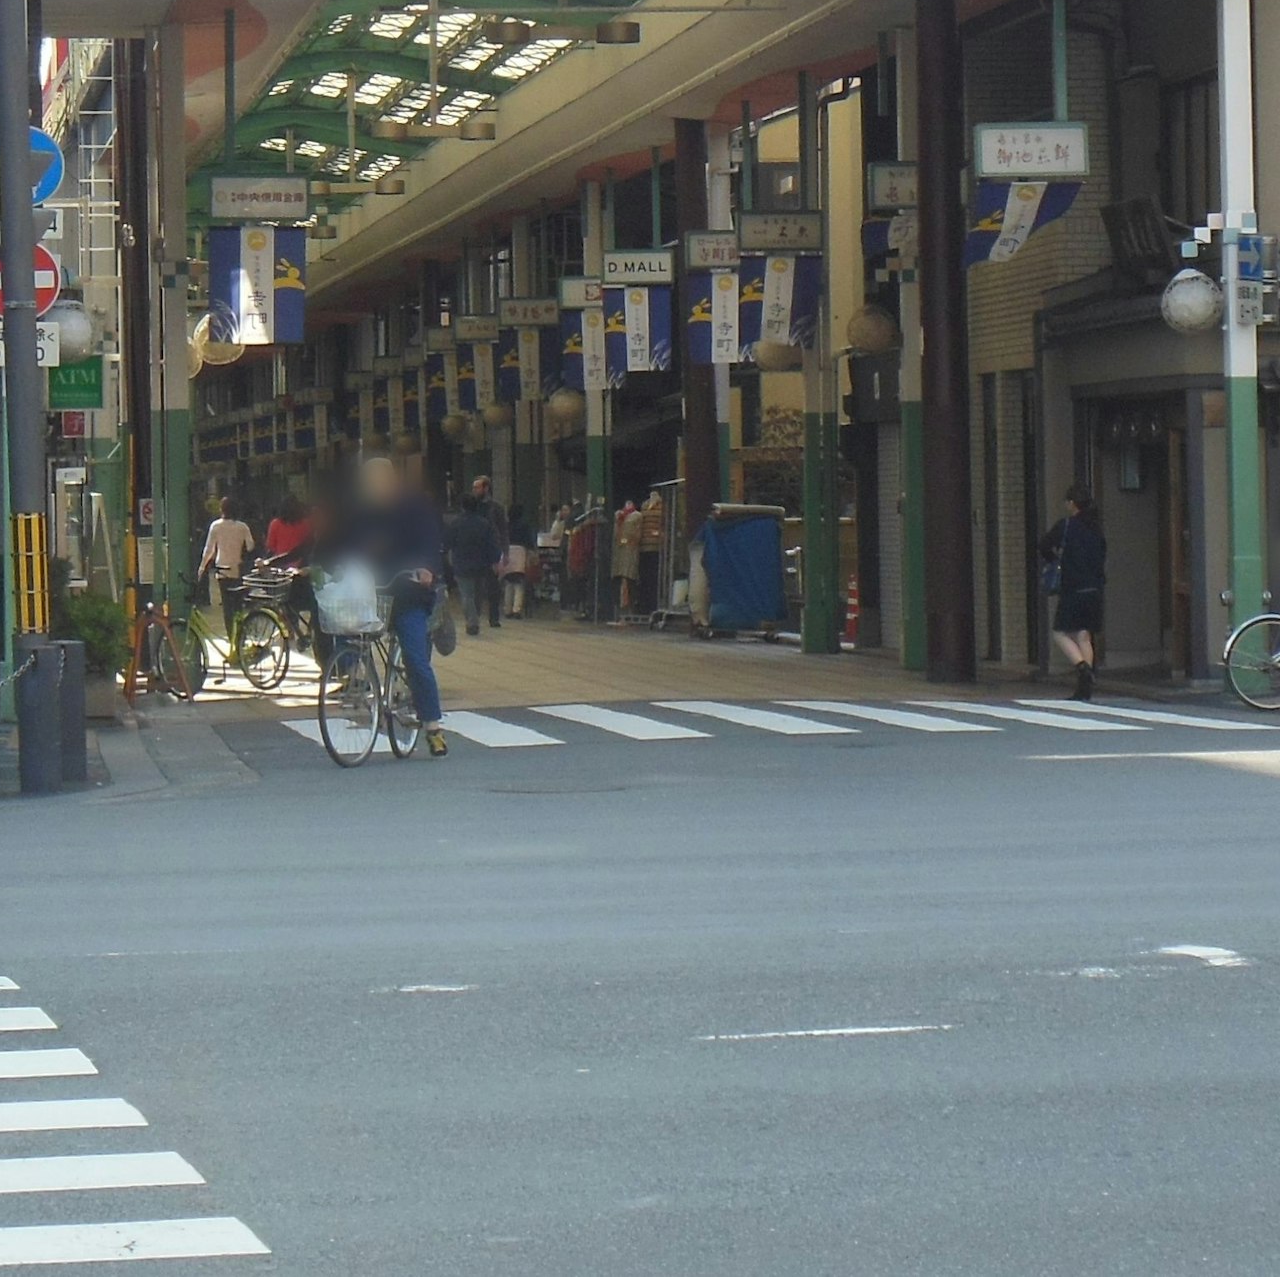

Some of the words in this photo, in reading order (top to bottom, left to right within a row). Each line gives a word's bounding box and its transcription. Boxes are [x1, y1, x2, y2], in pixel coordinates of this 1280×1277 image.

[608, 262, 618, 274] D
[625, 261, 667, 273] MALL
[631, 332, 647, 362] 寺町
[716, 321, 734, 353] 寺町
[54, 369, 97, 385] ATM
